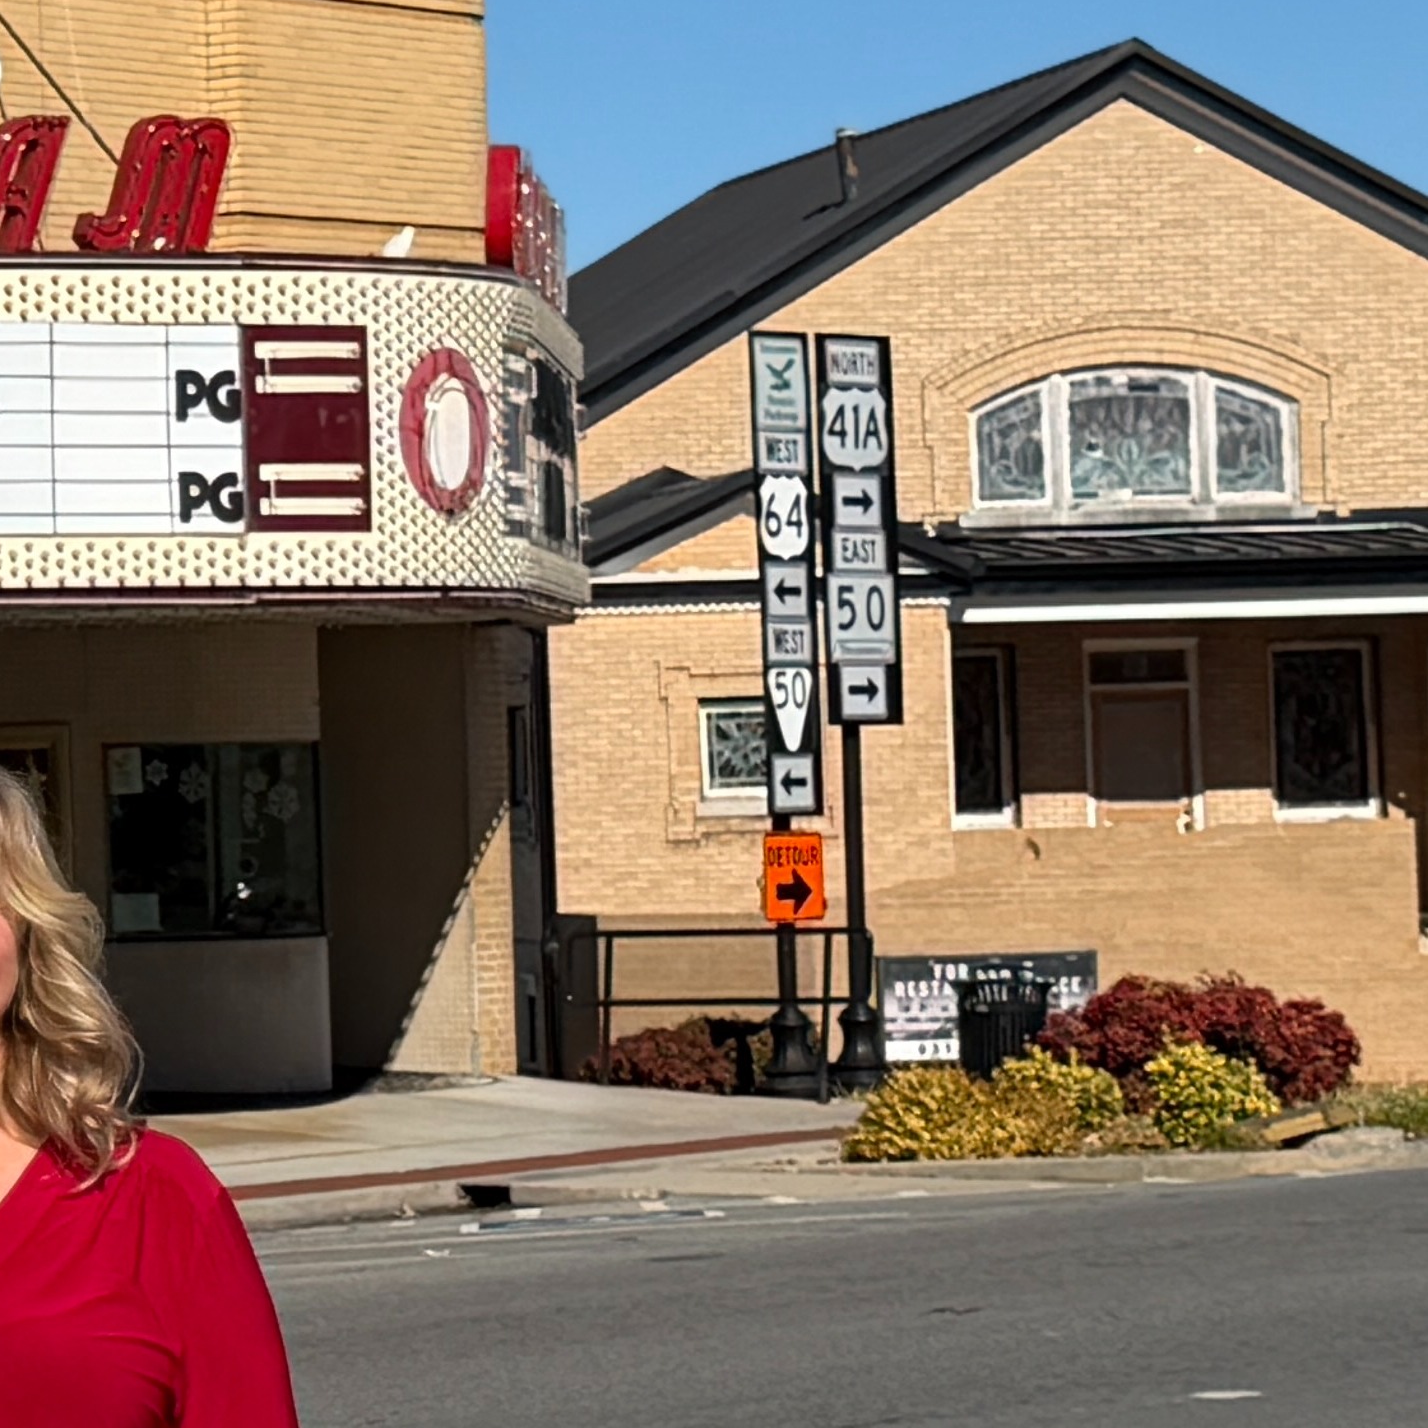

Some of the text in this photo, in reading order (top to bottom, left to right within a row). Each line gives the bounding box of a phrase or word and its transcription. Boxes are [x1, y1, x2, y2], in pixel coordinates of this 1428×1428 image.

[831, 353, 875, 376] NORTH
[175, 370, 241, 423] PG
[827, 403, 882, 451] 41A
[765, 438, 799, 464] WEST
[179, 471, 243, 523] PG
[764, 492, 804, 539] 64
[841, 537, 876, 563] EAST
[837, 584, 886, 632] 50
[771, 628, 805, 655] WEST
[775, 670, 807, 710] 50
[767, 845, 819, 868] DETOUR
